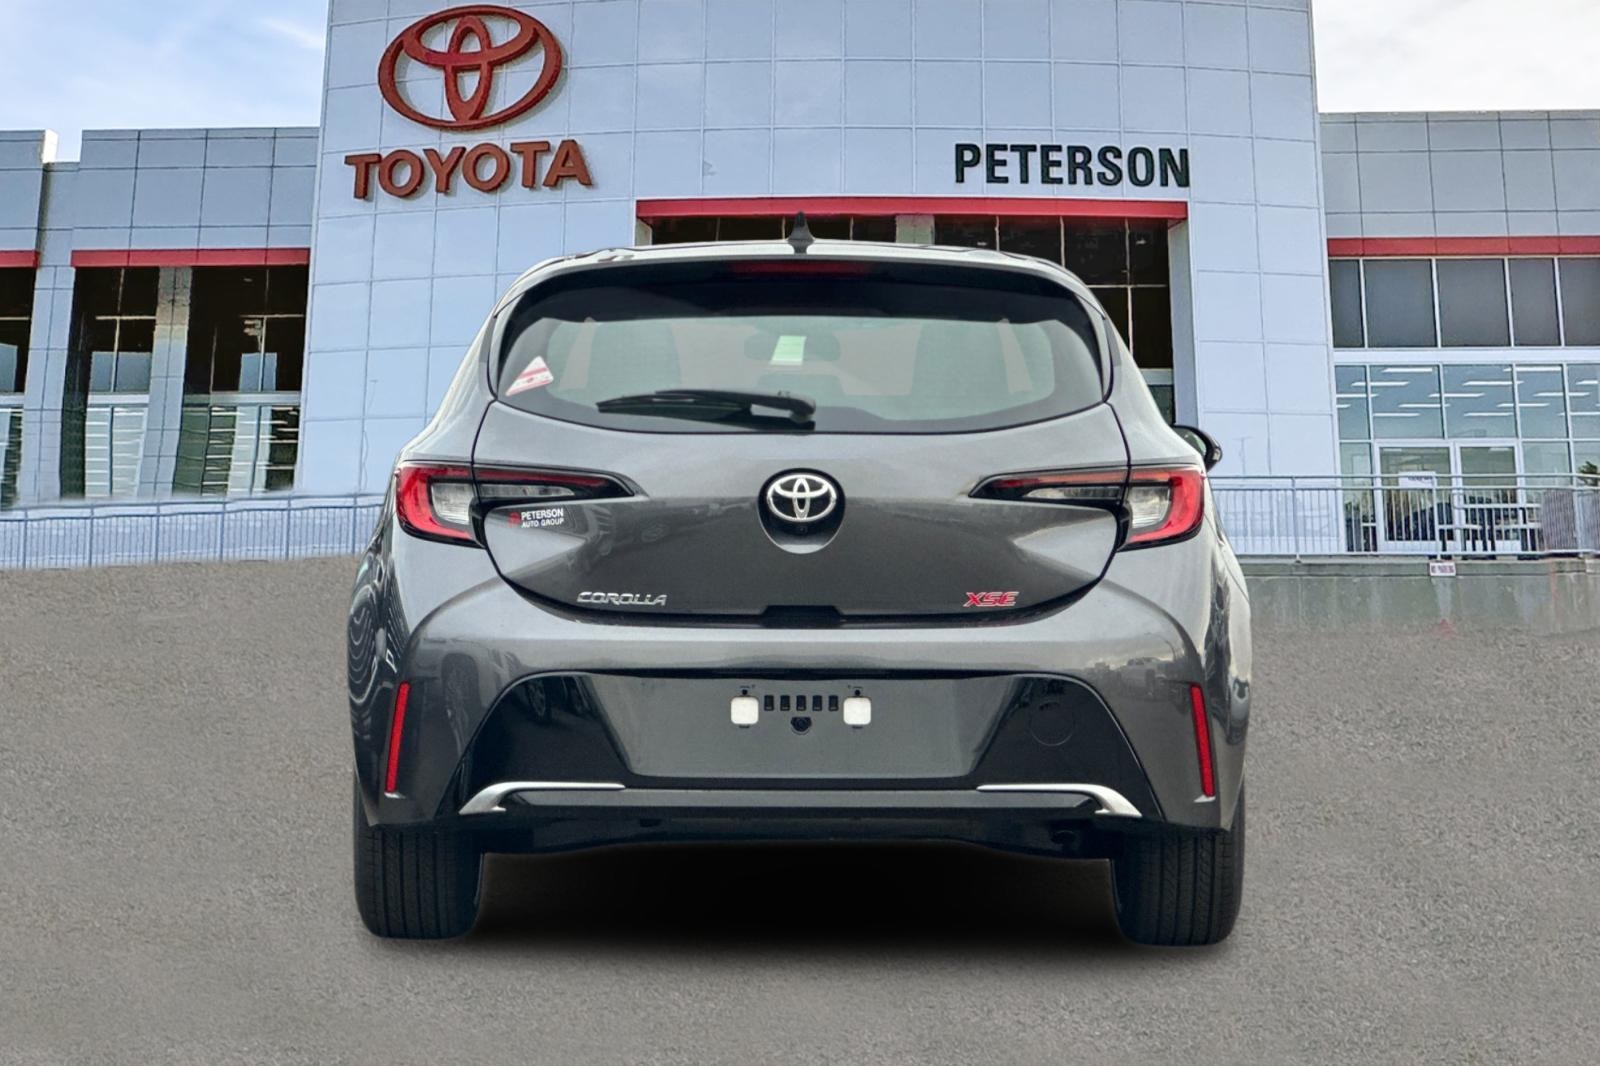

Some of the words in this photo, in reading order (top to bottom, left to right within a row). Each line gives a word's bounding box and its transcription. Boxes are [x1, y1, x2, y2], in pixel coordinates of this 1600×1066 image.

[344, 139, 593, 200] TOYOTA
[954, 143, 1190, 188] PETERSON
[520, 508, 564, 521] PETERSON
[521, 519, 540, 528] AUTO
[541, 517, 565, 527] GROUP
[576, 591, 668, 607] COROLLA
[962, 591, 1020, 608] XSE
